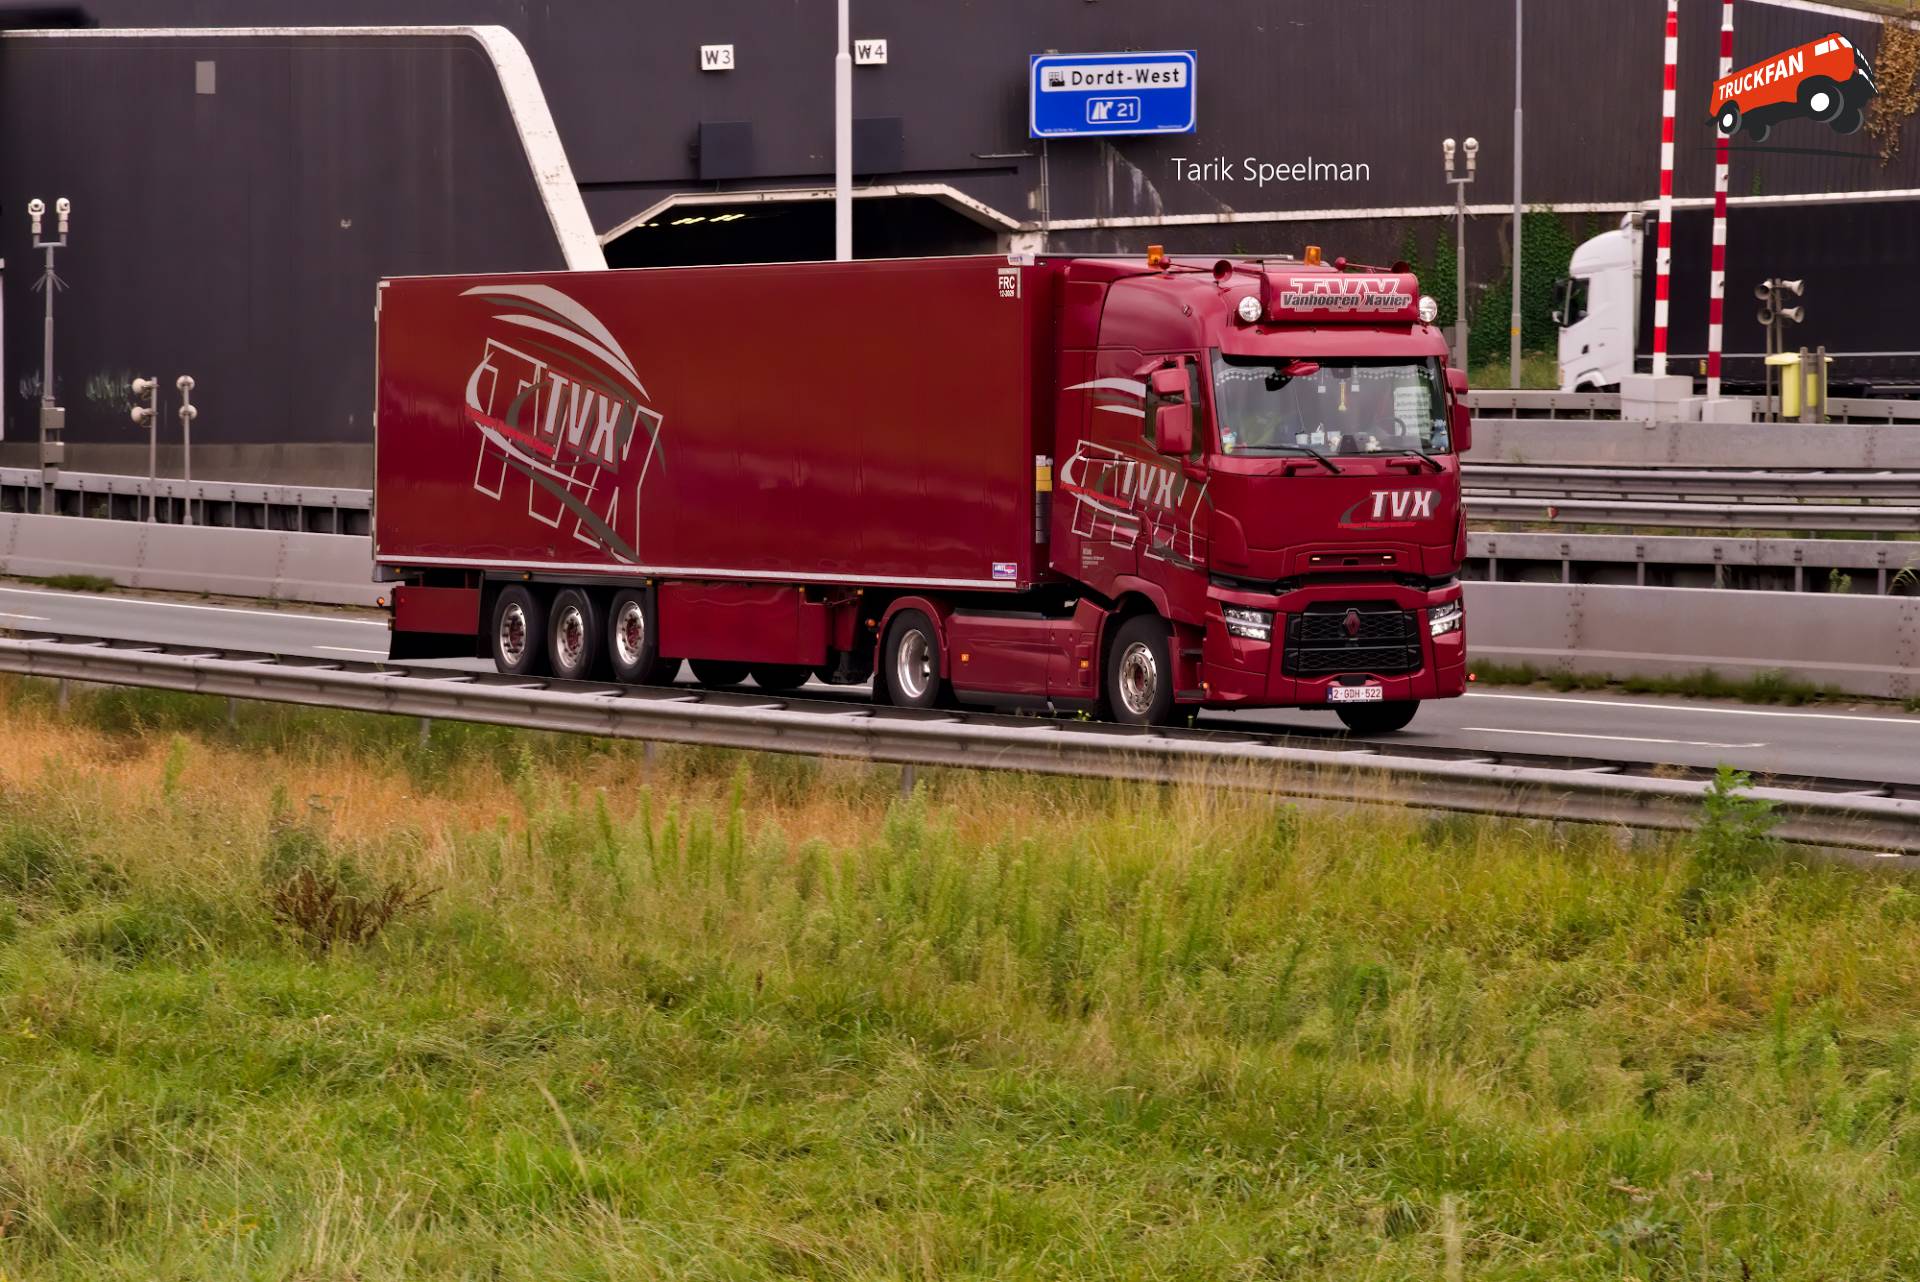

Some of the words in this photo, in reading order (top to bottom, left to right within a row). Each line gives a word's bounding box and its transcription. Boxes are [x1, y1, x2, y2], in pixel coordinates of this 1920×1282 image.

[1072, 68, 1180, 86] Dordt-West
[1117, 103, 1134, 117] 21
[999, 276, 1015, 290] FRC
[1283, 294, 1360, 306] Vanhooren
[1365, 294, 1410, 306] Xavier
[544, 371, 622, 464] TVX
[1122, 462, 1176, 509] TVX
[1371, 491, 1432, 517] TVX
